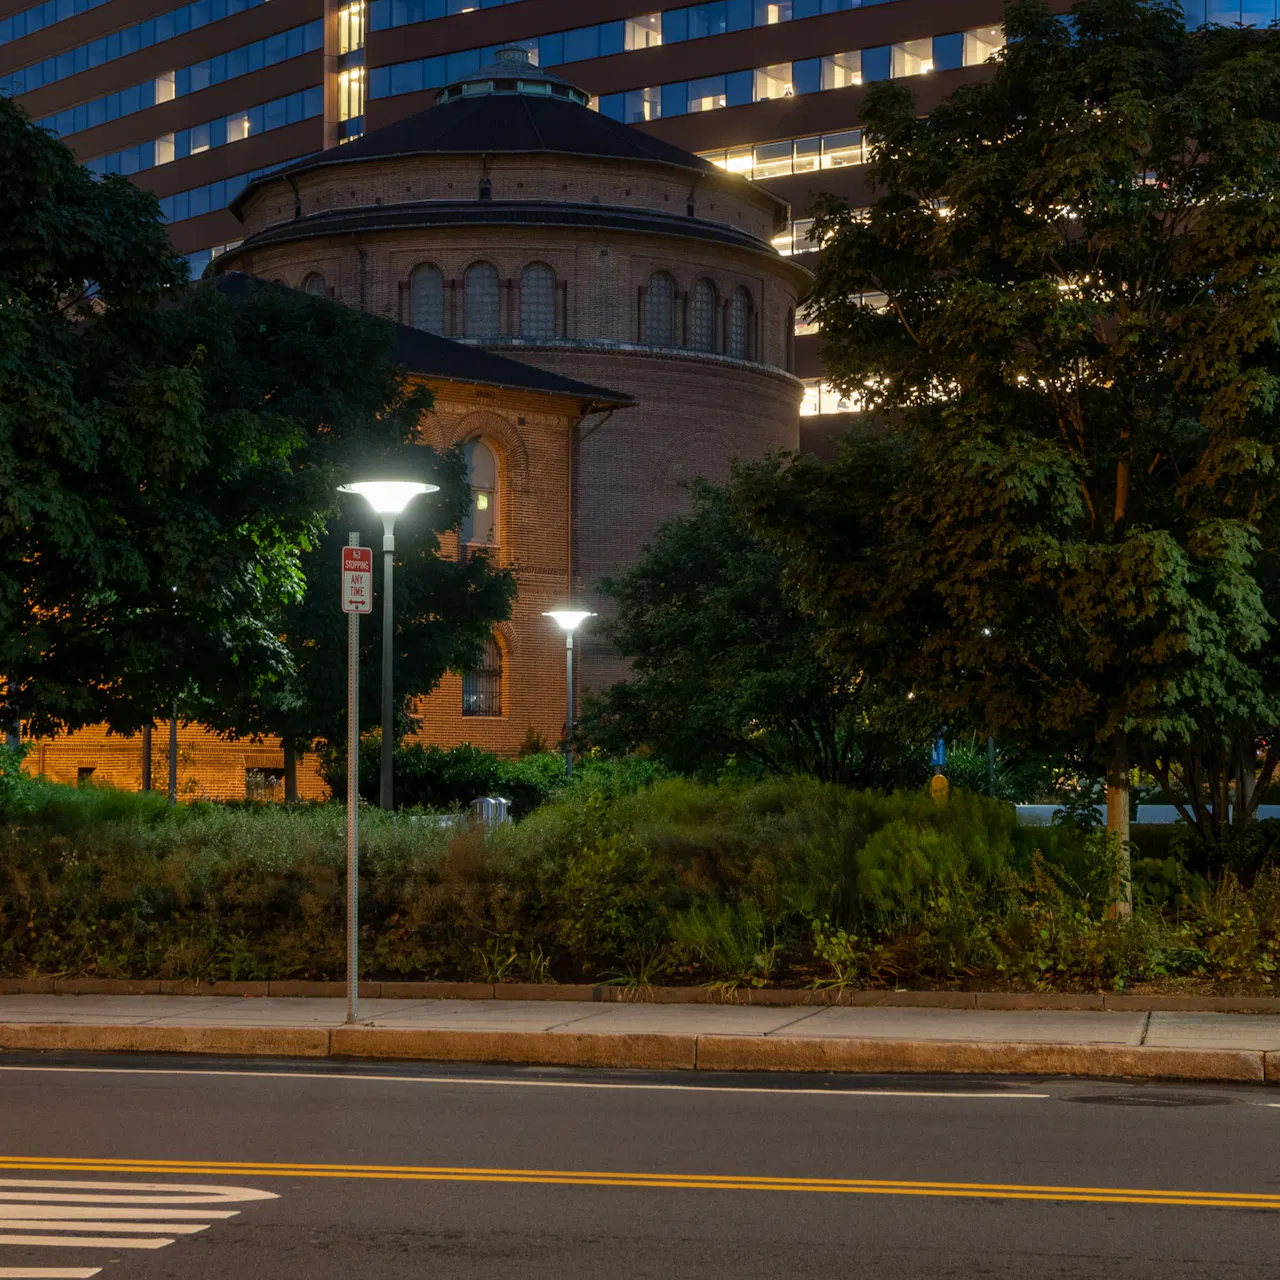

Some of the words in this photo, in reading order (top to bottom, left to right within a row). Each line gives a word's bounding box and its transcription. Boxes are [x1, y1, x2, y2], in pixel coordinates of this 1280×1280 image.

[353, 550, 361, 559] NO
[345, 560, 369, 570] STOPPING
[351, 574, 364, 584] ANY
[351, 586, 364, 596] TIME
